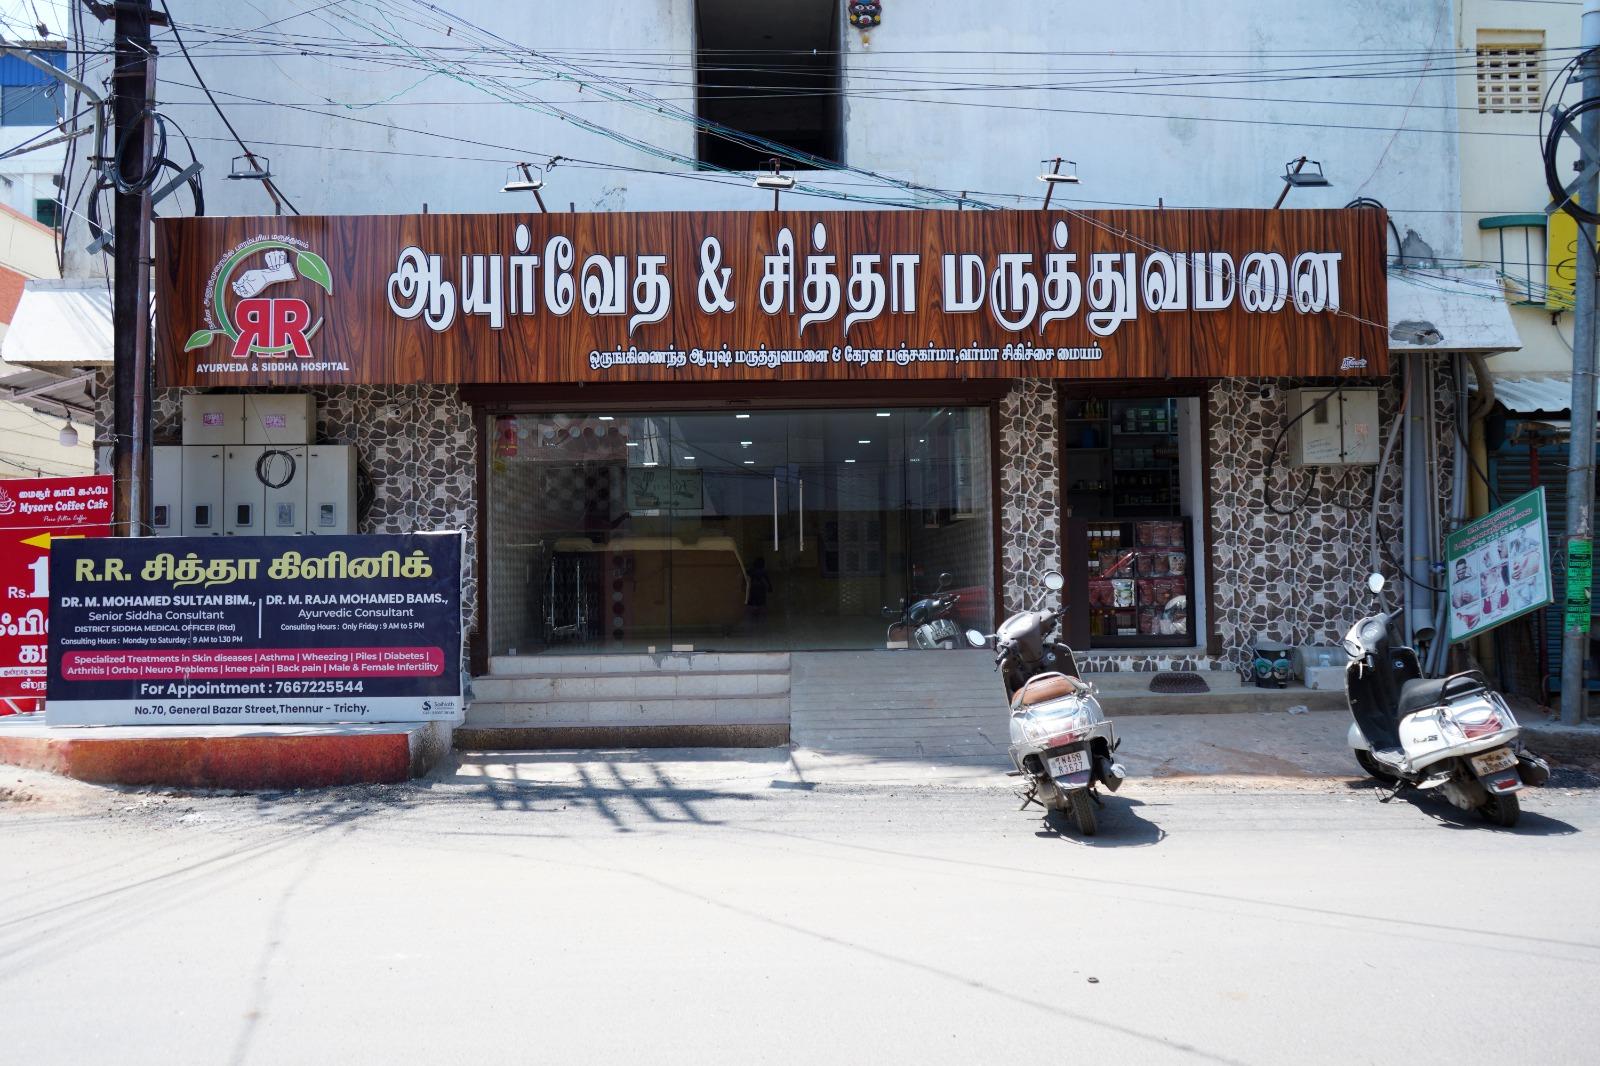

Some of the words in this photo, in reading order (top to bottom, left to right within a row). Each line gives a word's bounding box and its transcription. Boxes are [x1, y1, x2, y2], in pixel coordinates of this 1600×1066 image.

[388, 223, 671, 338] ஆயுர்வேத
[698, 235, 736, 314] &
[760, 221, 920, 336] சித்தா
[943, 219, 1342, 336] மருத்துவமனை
[689, 344, 732, 368] ஆயுஷ்
[735, 343, 829, 368] மருத்துவமனை
[831, 346, 841, 362] &
[844, 345, 884, 366] கேரள
[1001, 341, 1054, 361] சிகிச்சை
[1057, 341, 1102, 361] மையம்
[196, 363, 248, 373] AYURVEDA
[251, 363, 258, 372] &
[261, 362, 298, 372] SIDDHA
[301, 361, 349, 371] HOSPITAL
[53, 486, 76, 497] காபி
[19, 502, 53, 514] Mysore
[55, 500, 85, 511] Coffee
[87, 499, 108, 509] Cafe
[75, 558, 131, 581] R.R.
[141, 553, 260, 590] சித்தா
[267, 549, 433, 580] கிளினிக்
[8, 587, 30, 599] Rs.
[61, 597, 82, 608] DR.
[85, 596, 100, 607] M.
[102, 596, 171, 607] MOHAMED
[173, 595, 223, 606] SULTAN
[266, 594, 286, 605] DR.
[288, 594, 303, 605] M.
[305, 594, 337, 605] RAJA
[339, 594, 404, 604] MOHAMED
[88, 611, 123, 621] Senior
[125, 611, 162, 621] Siddha
[165, 610, 224, 620] Consultant
[298, 608, 352, 619] Ayurvedic
[354, 607, 414, 617] Consultant
[217, 624, 236, 632] (Rtd)
[280, 623, 316, 631] Consulting
[342, 623, 357, 631] Only
[358, 622, 378, 631] Friday
[61, 637, 96, 646] Consulting
[122, 637, 149, 645] Monday
[74, 655, 125, 665] Specialized
[127, 655, 179, 663] Treatments
[181, 654, 190, 662] in
[192, 654, 212, 662] Skin
[214, 654, 252, 662] diseases
[301, 653, 348, 662] Wheezing
[355, 652, 377, 660] Piles
[384, 652, 424, 660] Diabetes
[67, 666, 105, 675] Arthritis
[145, 666, 173, 674] Neuro
[175, 665, 218, 673] Problems
[250, 665, 269, 674] pain
[276, 664, 300, 672] Back
[301, 664, 321, 673] pain
[361, 663, 395, 671] Female
[397, 662, 439, 673] Infertility
[140, 683, 164, 695] For
[167, 681, 265, 698] Appointment
[275, 680, 364, 694] 7667225544
[134, 706, 166, 716] No.70,
[169, 705, 210, 714] General
[213, 705, 243, 714] Bazar
[333, 703, 369, 715] Trichy.
